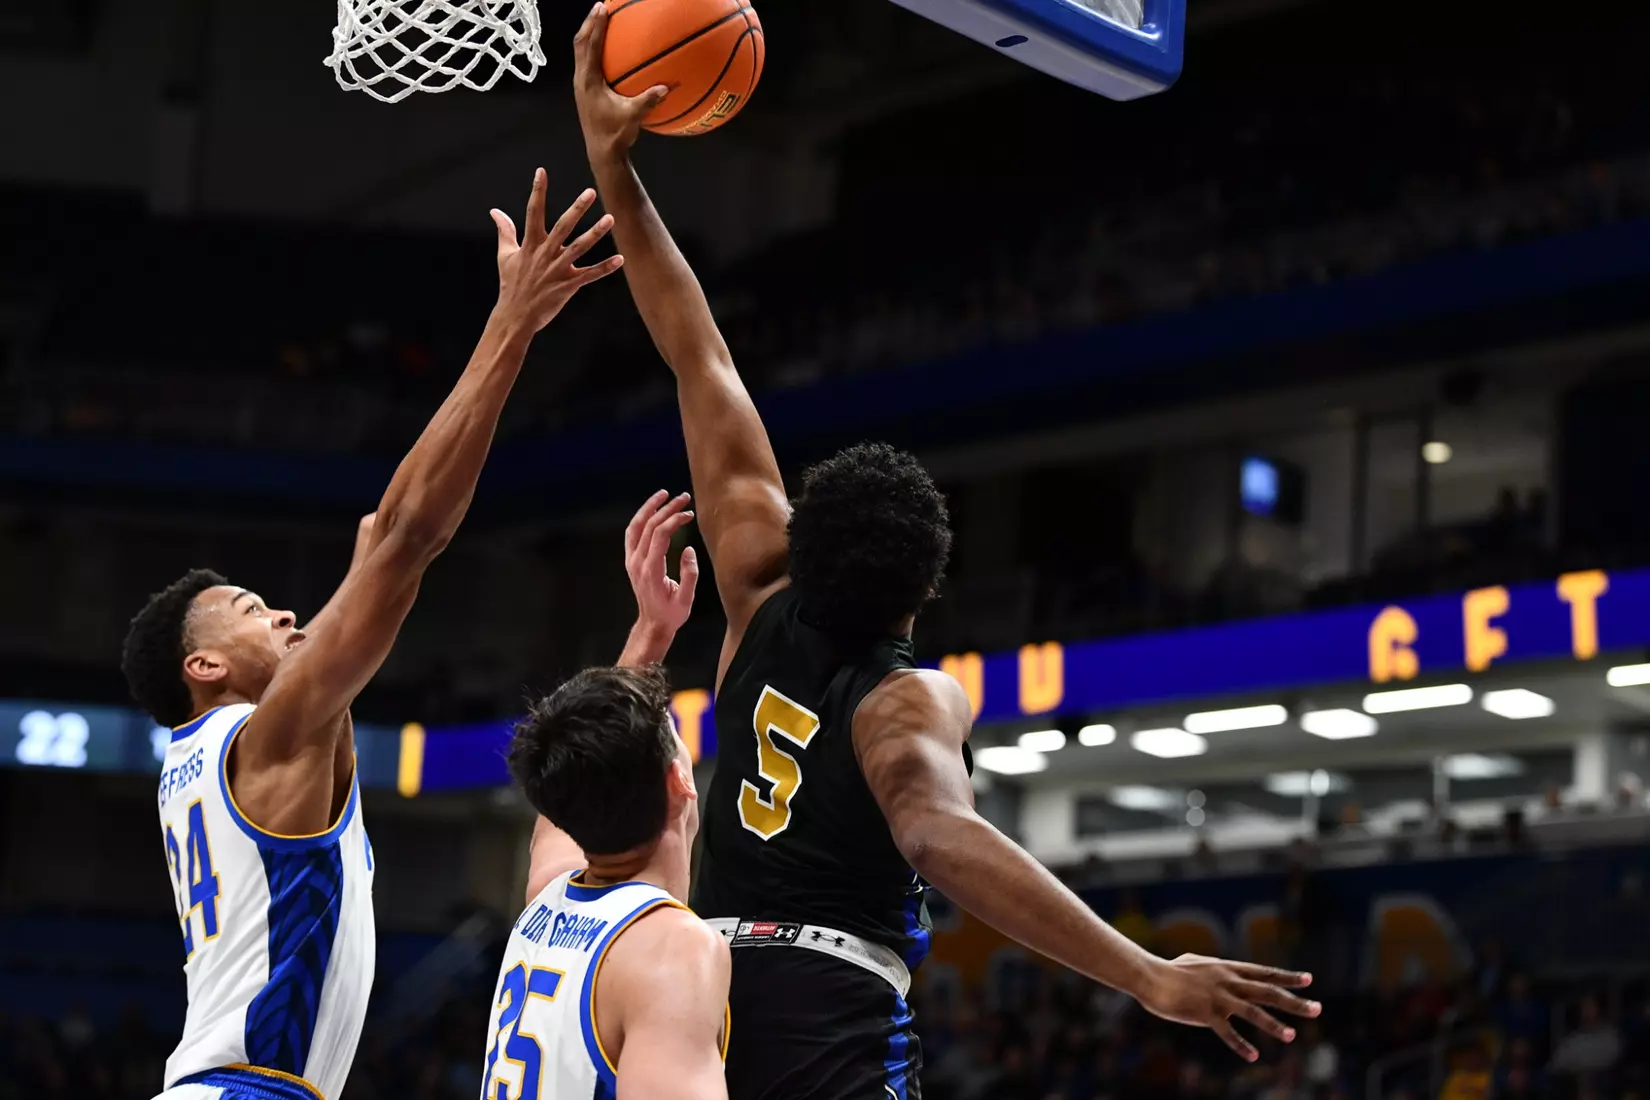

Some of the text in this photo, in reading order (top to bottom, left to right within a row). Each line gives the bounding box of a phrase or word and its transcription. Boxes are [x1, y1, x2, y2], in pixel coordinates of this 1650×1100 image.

[15, 710, 90, 767] 22
[737, 684, 820, 842] 5
[165, 797, 222, 963] 24
